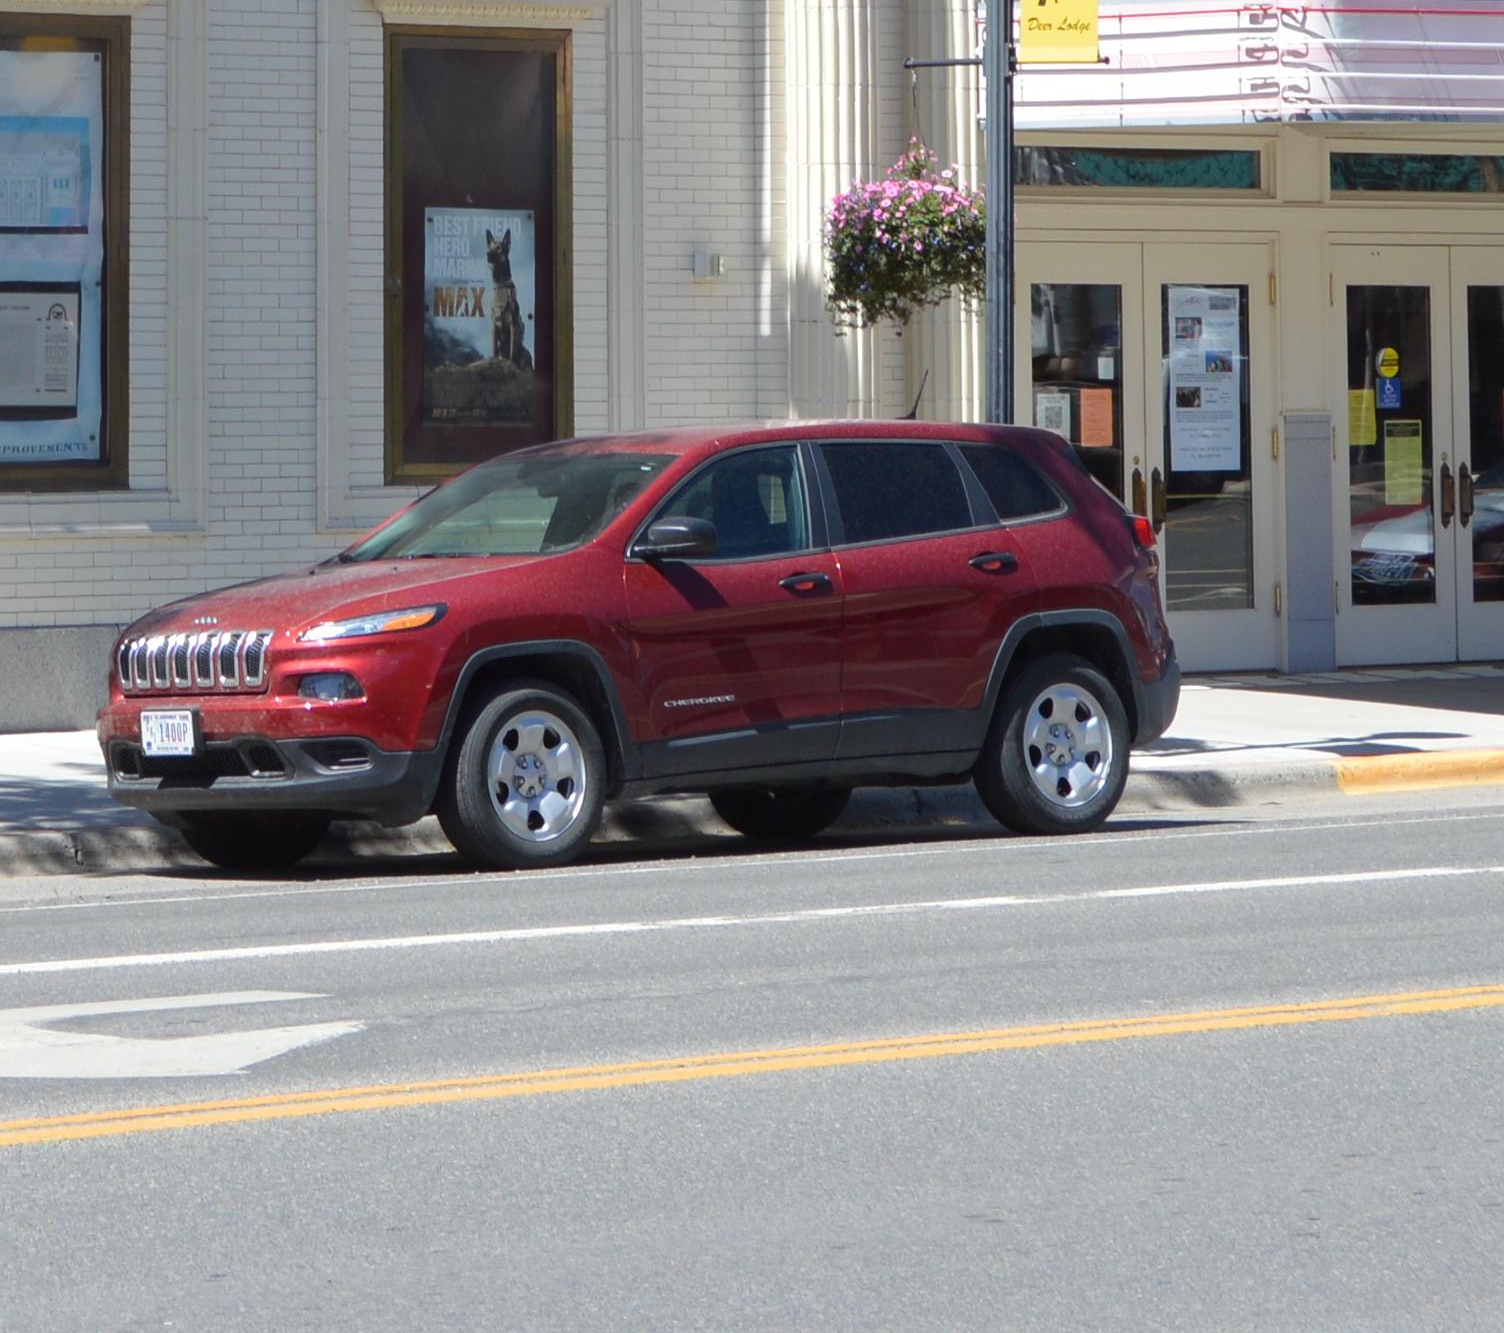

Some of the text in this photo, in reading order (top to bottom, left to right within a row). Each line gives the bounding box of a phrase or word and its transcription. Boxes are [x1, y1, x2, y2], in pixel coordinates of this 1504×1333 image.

[1027, 16, 1092, 34] Deer Lodge
[433, 215, 469, 236] BEST
[433, 285, 486, 318] MAX
[663, 694, 736, 709] CHEROKEE
